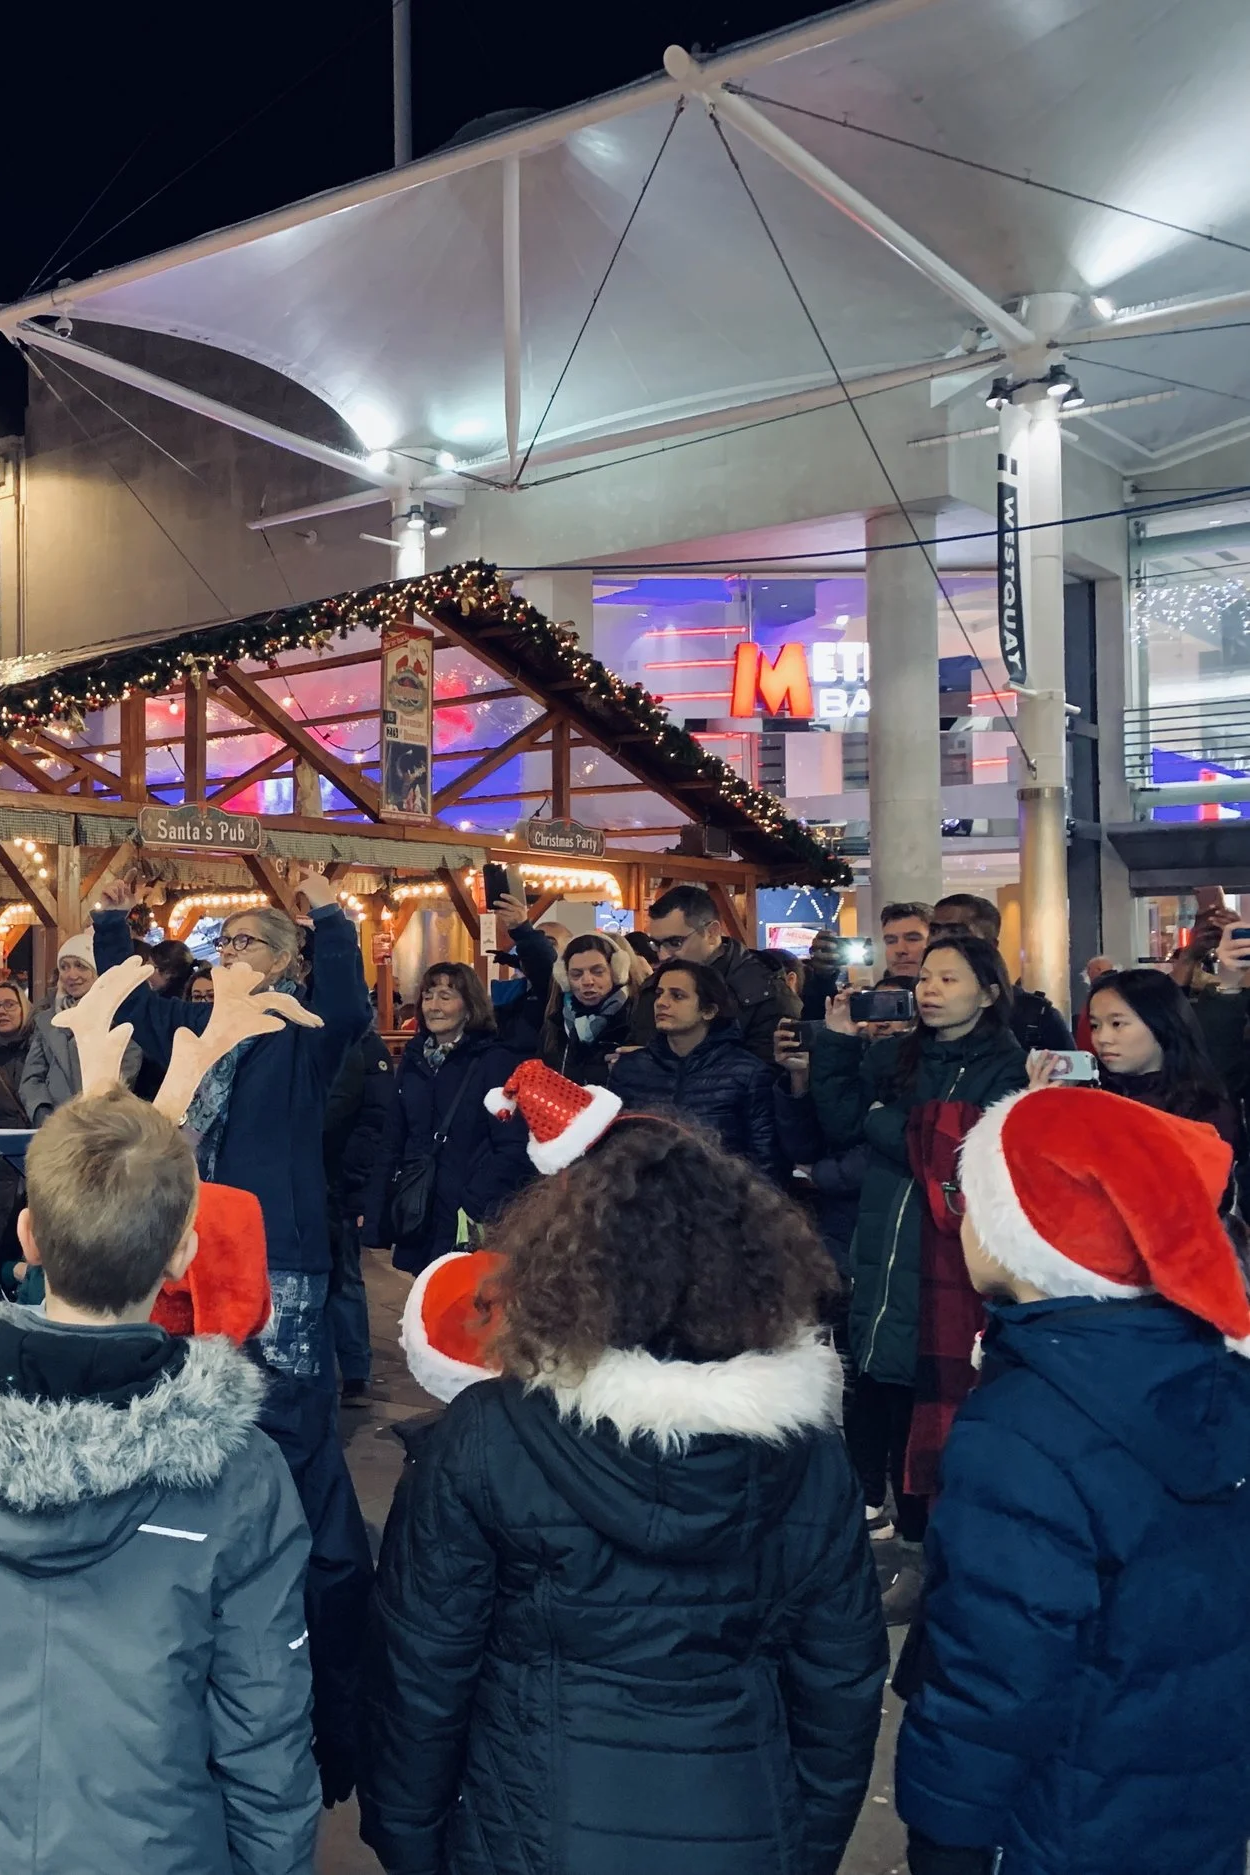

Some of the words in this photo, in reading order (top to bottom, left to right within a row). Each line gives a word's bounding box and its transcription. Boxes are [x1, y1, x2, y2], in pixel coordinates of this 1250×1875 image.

[1003, 496, 1022, 671] WESTQUAY
[819, 689, 870, 717] BA
[157, 818, 213, 841] Santa's
[218, 821, 245, 842] Pub
[535, 831, 575, 849] Christmas
[575, 834, 597, 854] Party
